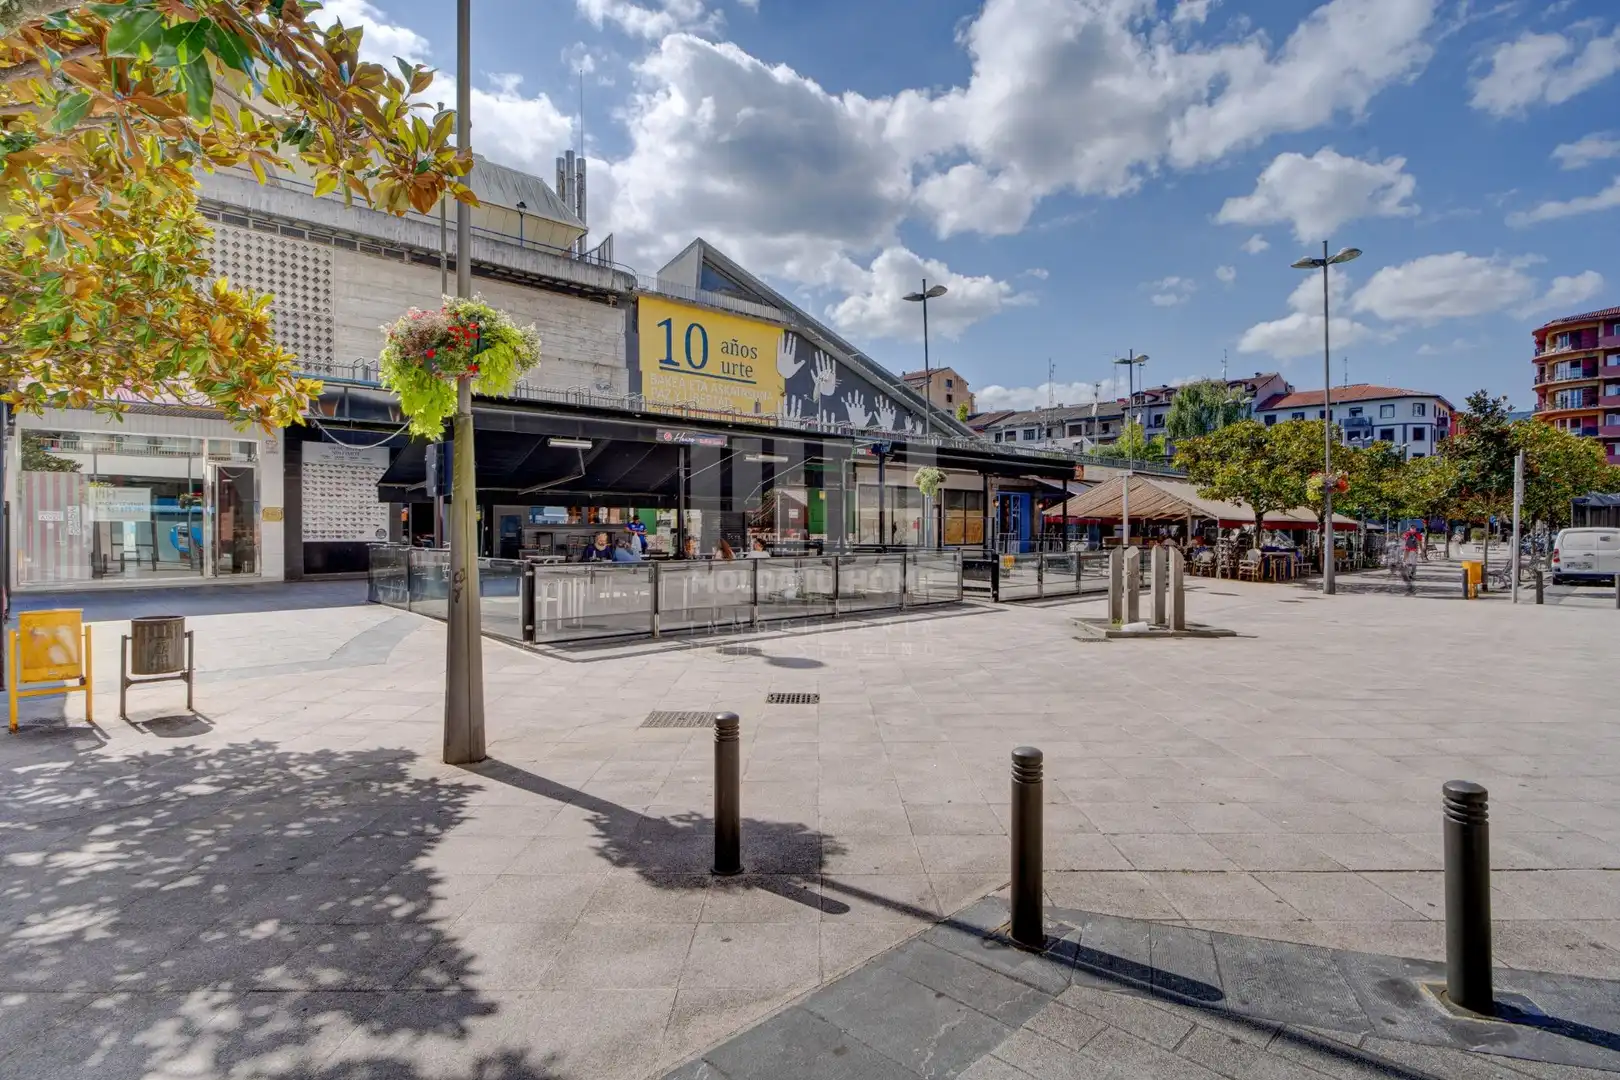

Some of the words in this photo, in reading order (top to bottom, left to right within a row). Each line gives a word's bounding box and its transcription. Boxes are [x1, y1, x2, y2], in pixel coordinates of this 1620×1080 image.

[656, 317, 709, 370] 10
[720, 338, 758, 360] años
[720, 360, 754, 379] urte
